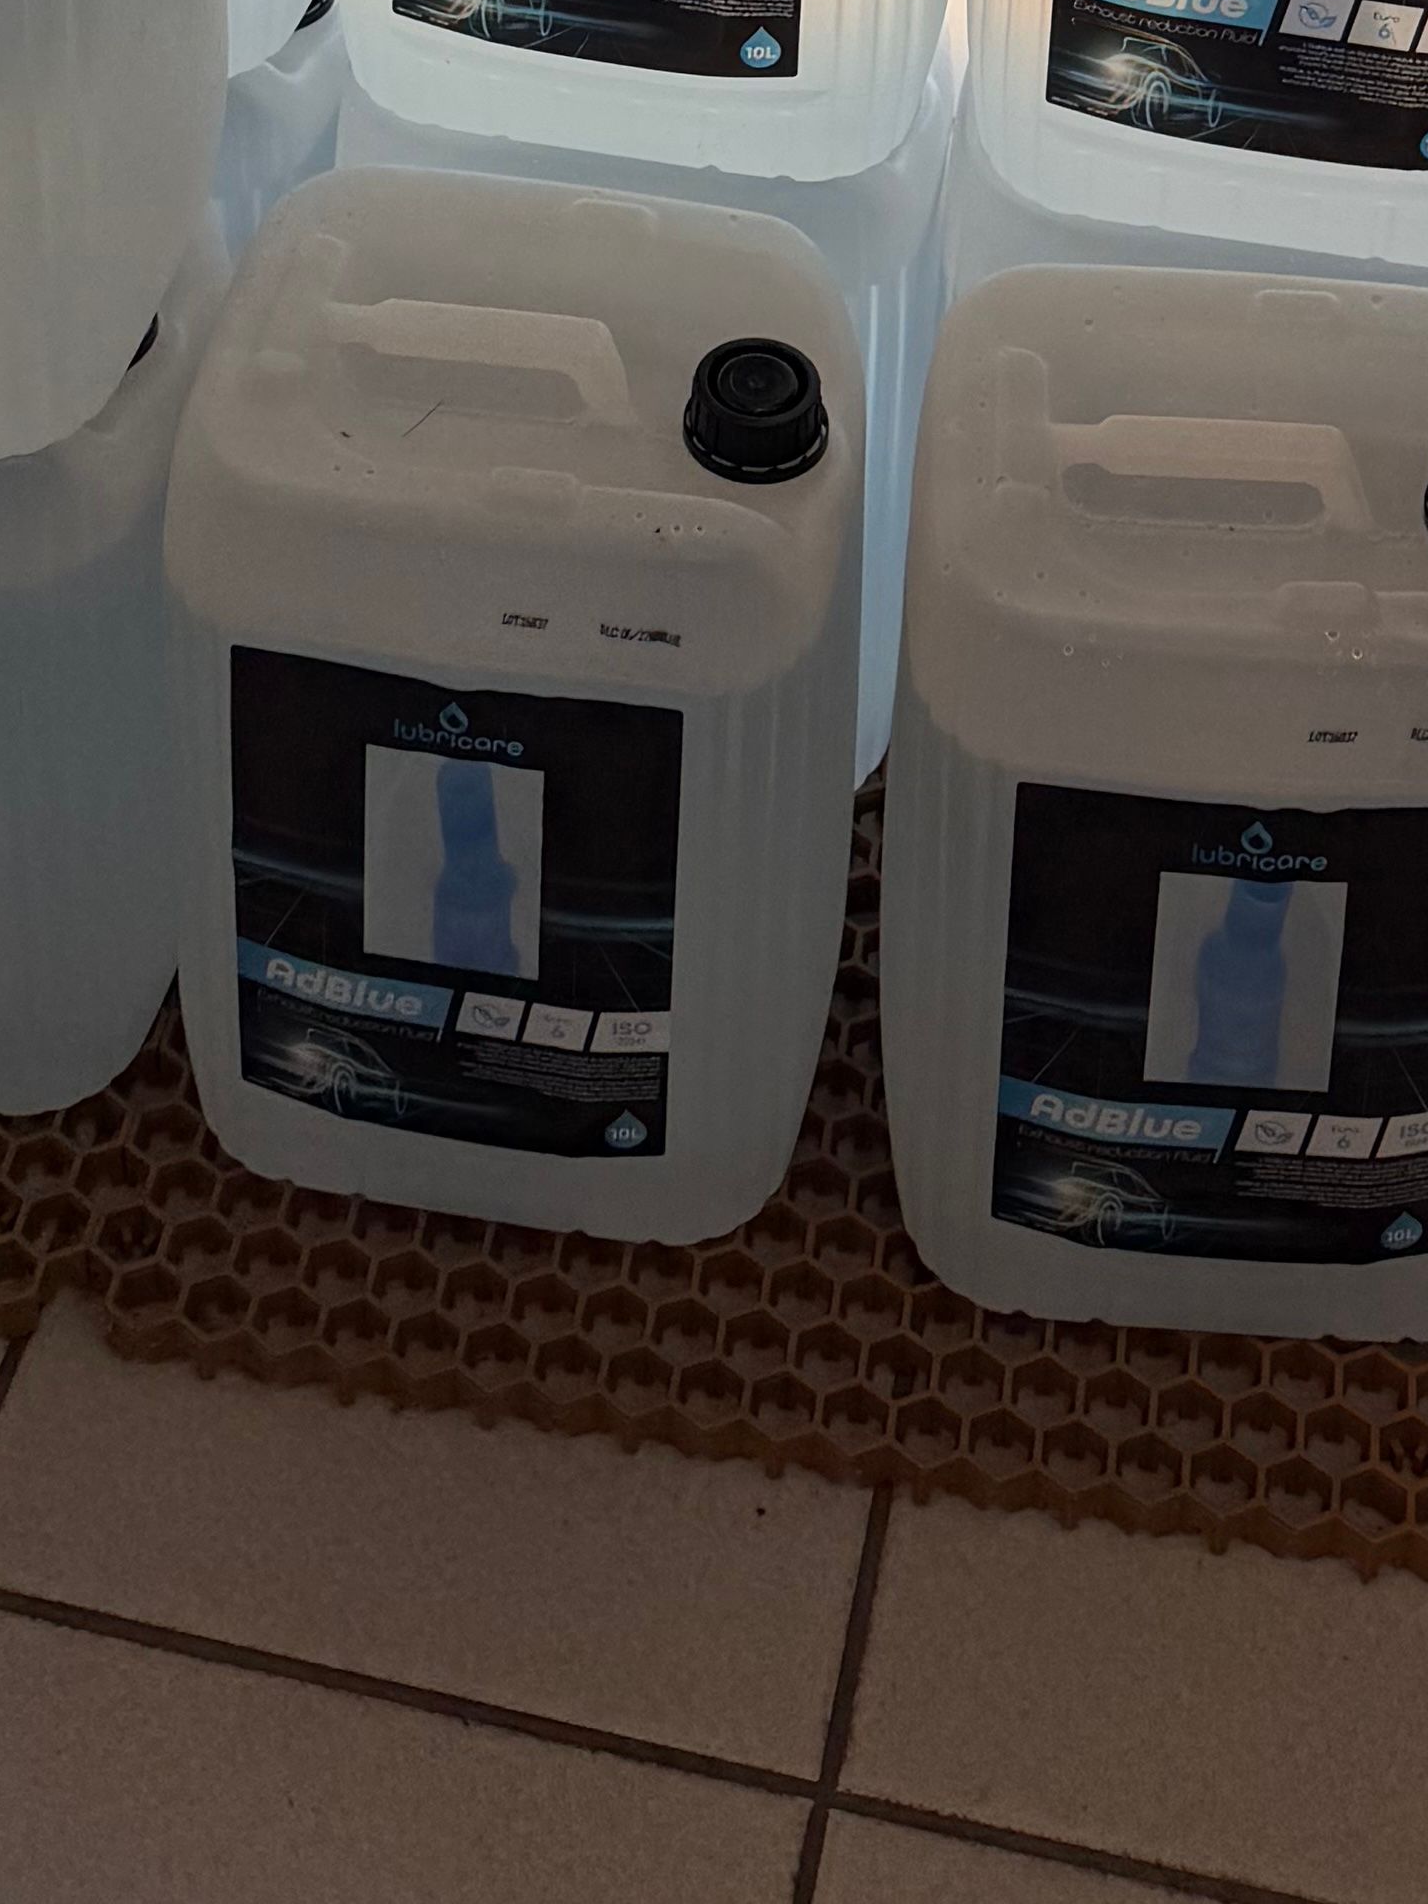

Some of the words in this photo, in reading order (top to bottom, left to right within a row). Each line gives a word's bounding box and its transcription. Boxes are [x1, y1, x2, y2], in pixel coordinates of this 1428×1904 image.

[1137, 12, 1220, 42] reduction
[1220, 25, 1258, 47] fluid
[744, 44, 778, 61] 10L
[393, 717, 525, 757] lubricare
[1190, 842, 1329, 873] lubricare
[265, 957, 425, 1017] AdBlue
[612, 1021, 653, 1036] ISO
[1029, 1092, 1203, 1142] AdBlue
[1385, 1229, 1416, 1244] 10L
